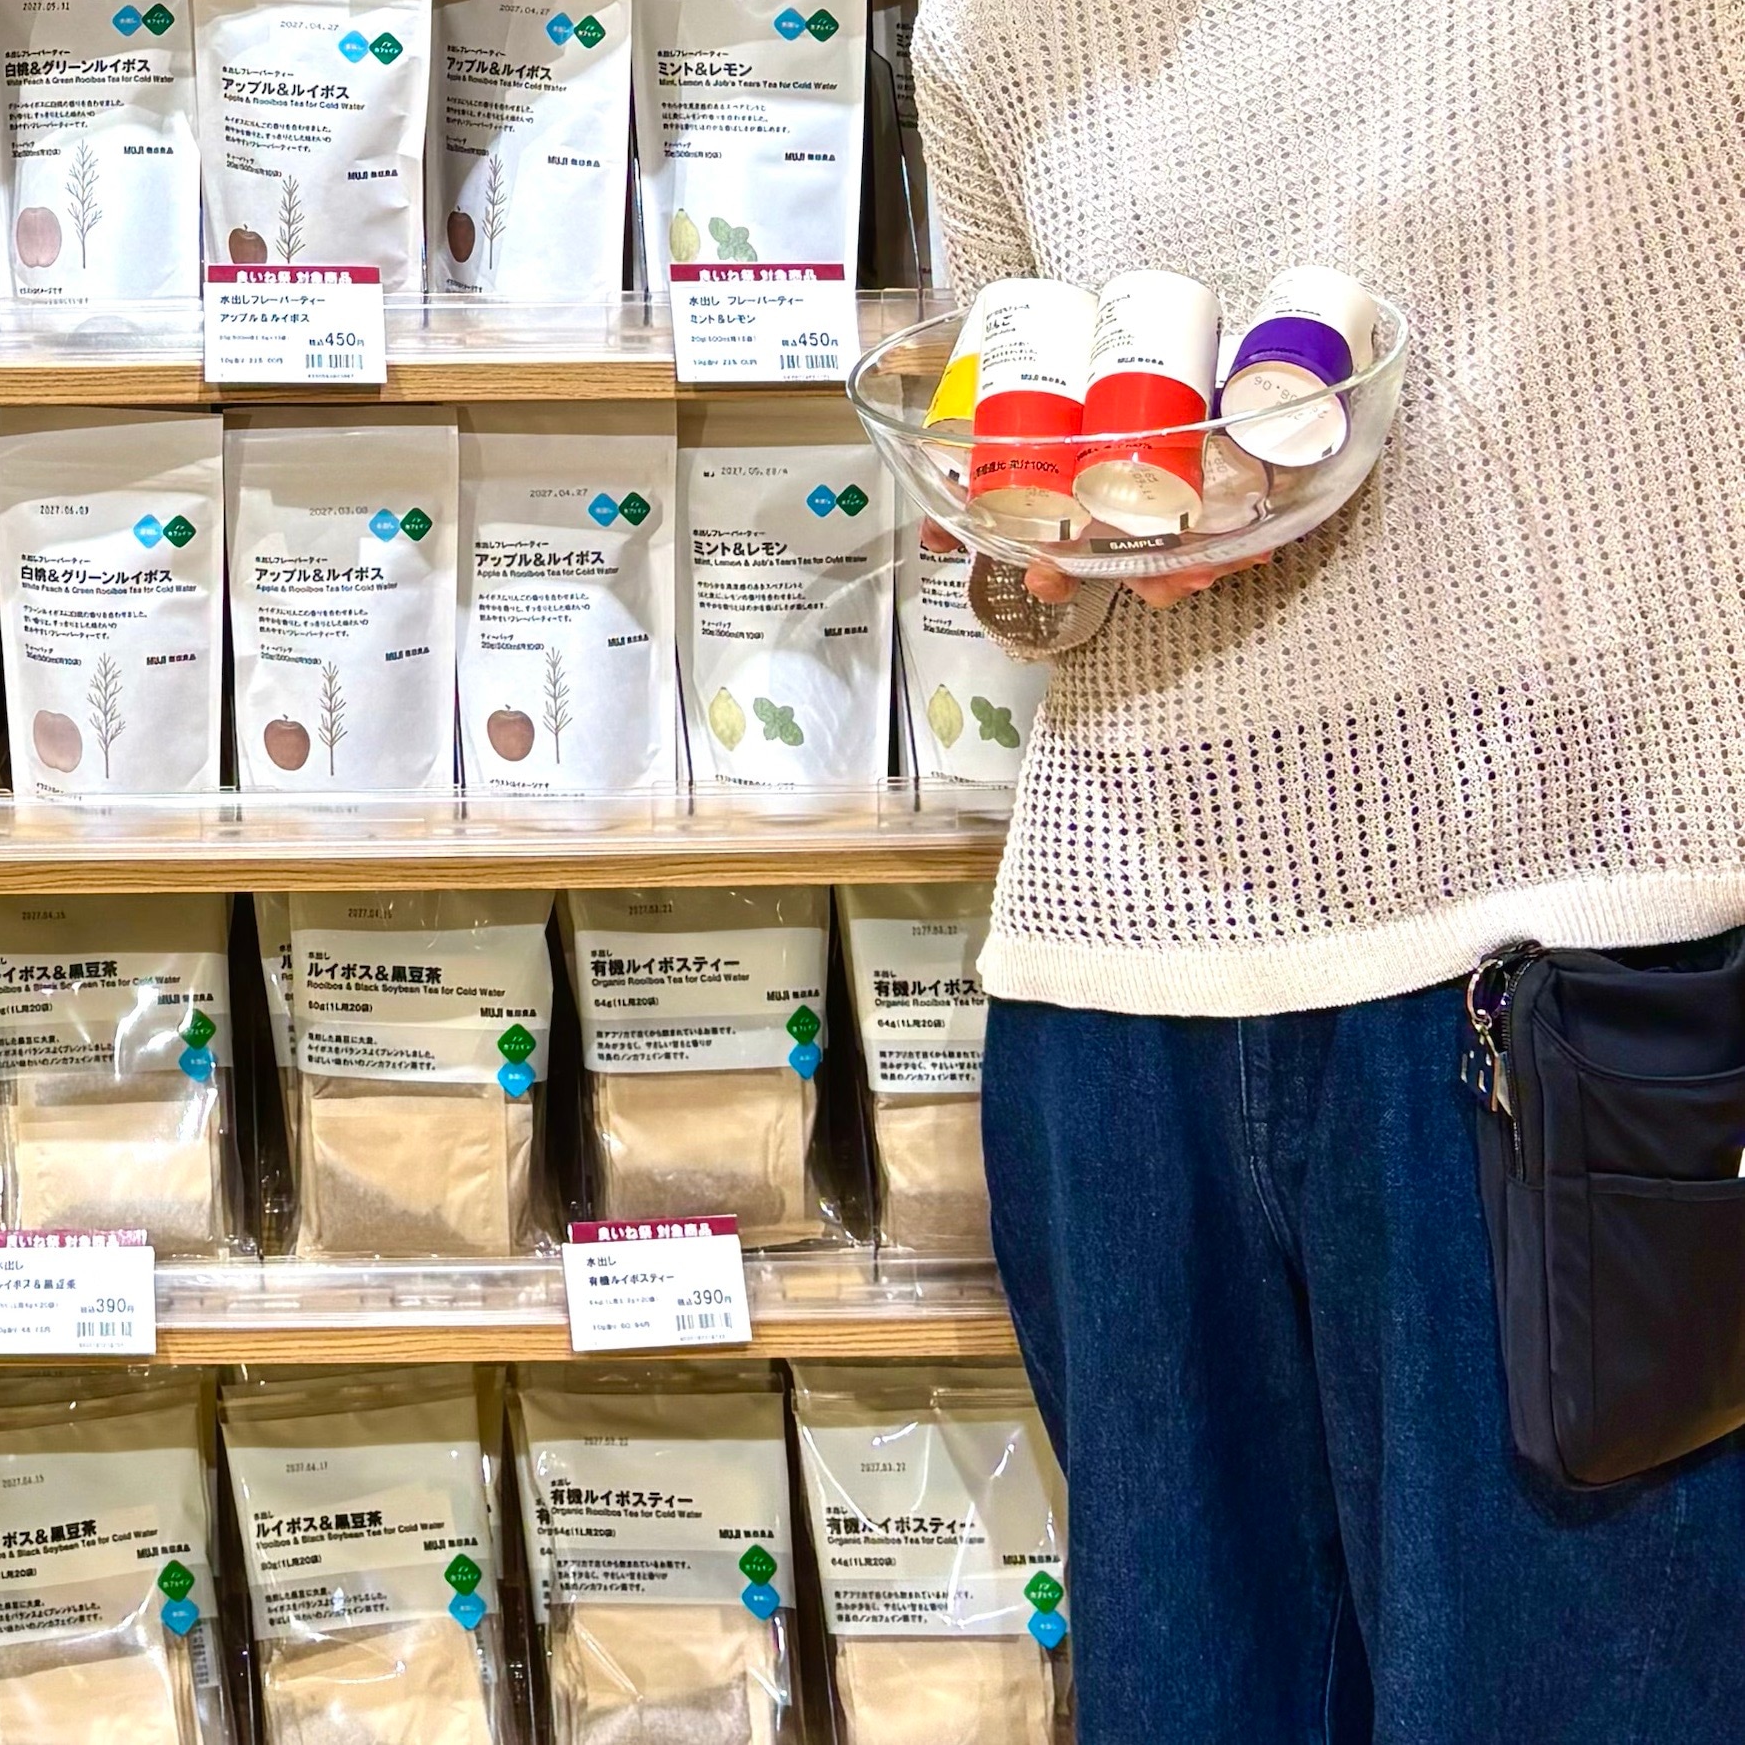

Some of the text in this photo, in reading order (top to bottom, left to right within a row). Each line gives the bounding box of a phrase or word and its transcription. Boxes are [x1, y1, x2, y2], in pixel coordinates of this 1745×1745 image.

[4, 58, 151, 77] 白桃&グリーンルイボス
[446, 58, 553, 81] アップル&ルイボス
[658, 61, 753, 77] ミント&レモン
[221, 77, 350, 100] アップル&ルイボス
[220, 295, 325, 305] 水出しフレーバーティー
[689, 296, 803, 306] 水出し フレーバーティー
[692, 539, 788, 556] ミント&レモン
[1109, 536, 1165, 550] SAMPLE
[474, 550, 606, 568] アップル&ルイボス
[20, 565, 173, 585] 白桃&グリーンルイボス
[254, 566, 384, 582] アップル&ルイボス
[307, 962, 442, 985] ルイボス&黒豆茶
[591, 956, 740, 976] 有機ルイボスティー
[628, 975, 664, 985] Rooibos
[666, 975, 683, 984] Tea
[685, 974, 698, 983] for
[700, 973, 721, 983] Cold
[723, 972, 749, 982] Water
[307, 980, 505, 997] Rooibos Black Soybean Tea for Cold Water
[480, 1007, 503, 1018] MUJI
[587, 1256, 617, 1267] 水出し
[589, 1272, 674, 1286] 有機ルイボスティー
[550, 1487, 693, 1508] 有機ルイボスティー
[255, 1511, 382, 1537] ルイボス&黒豆茶
